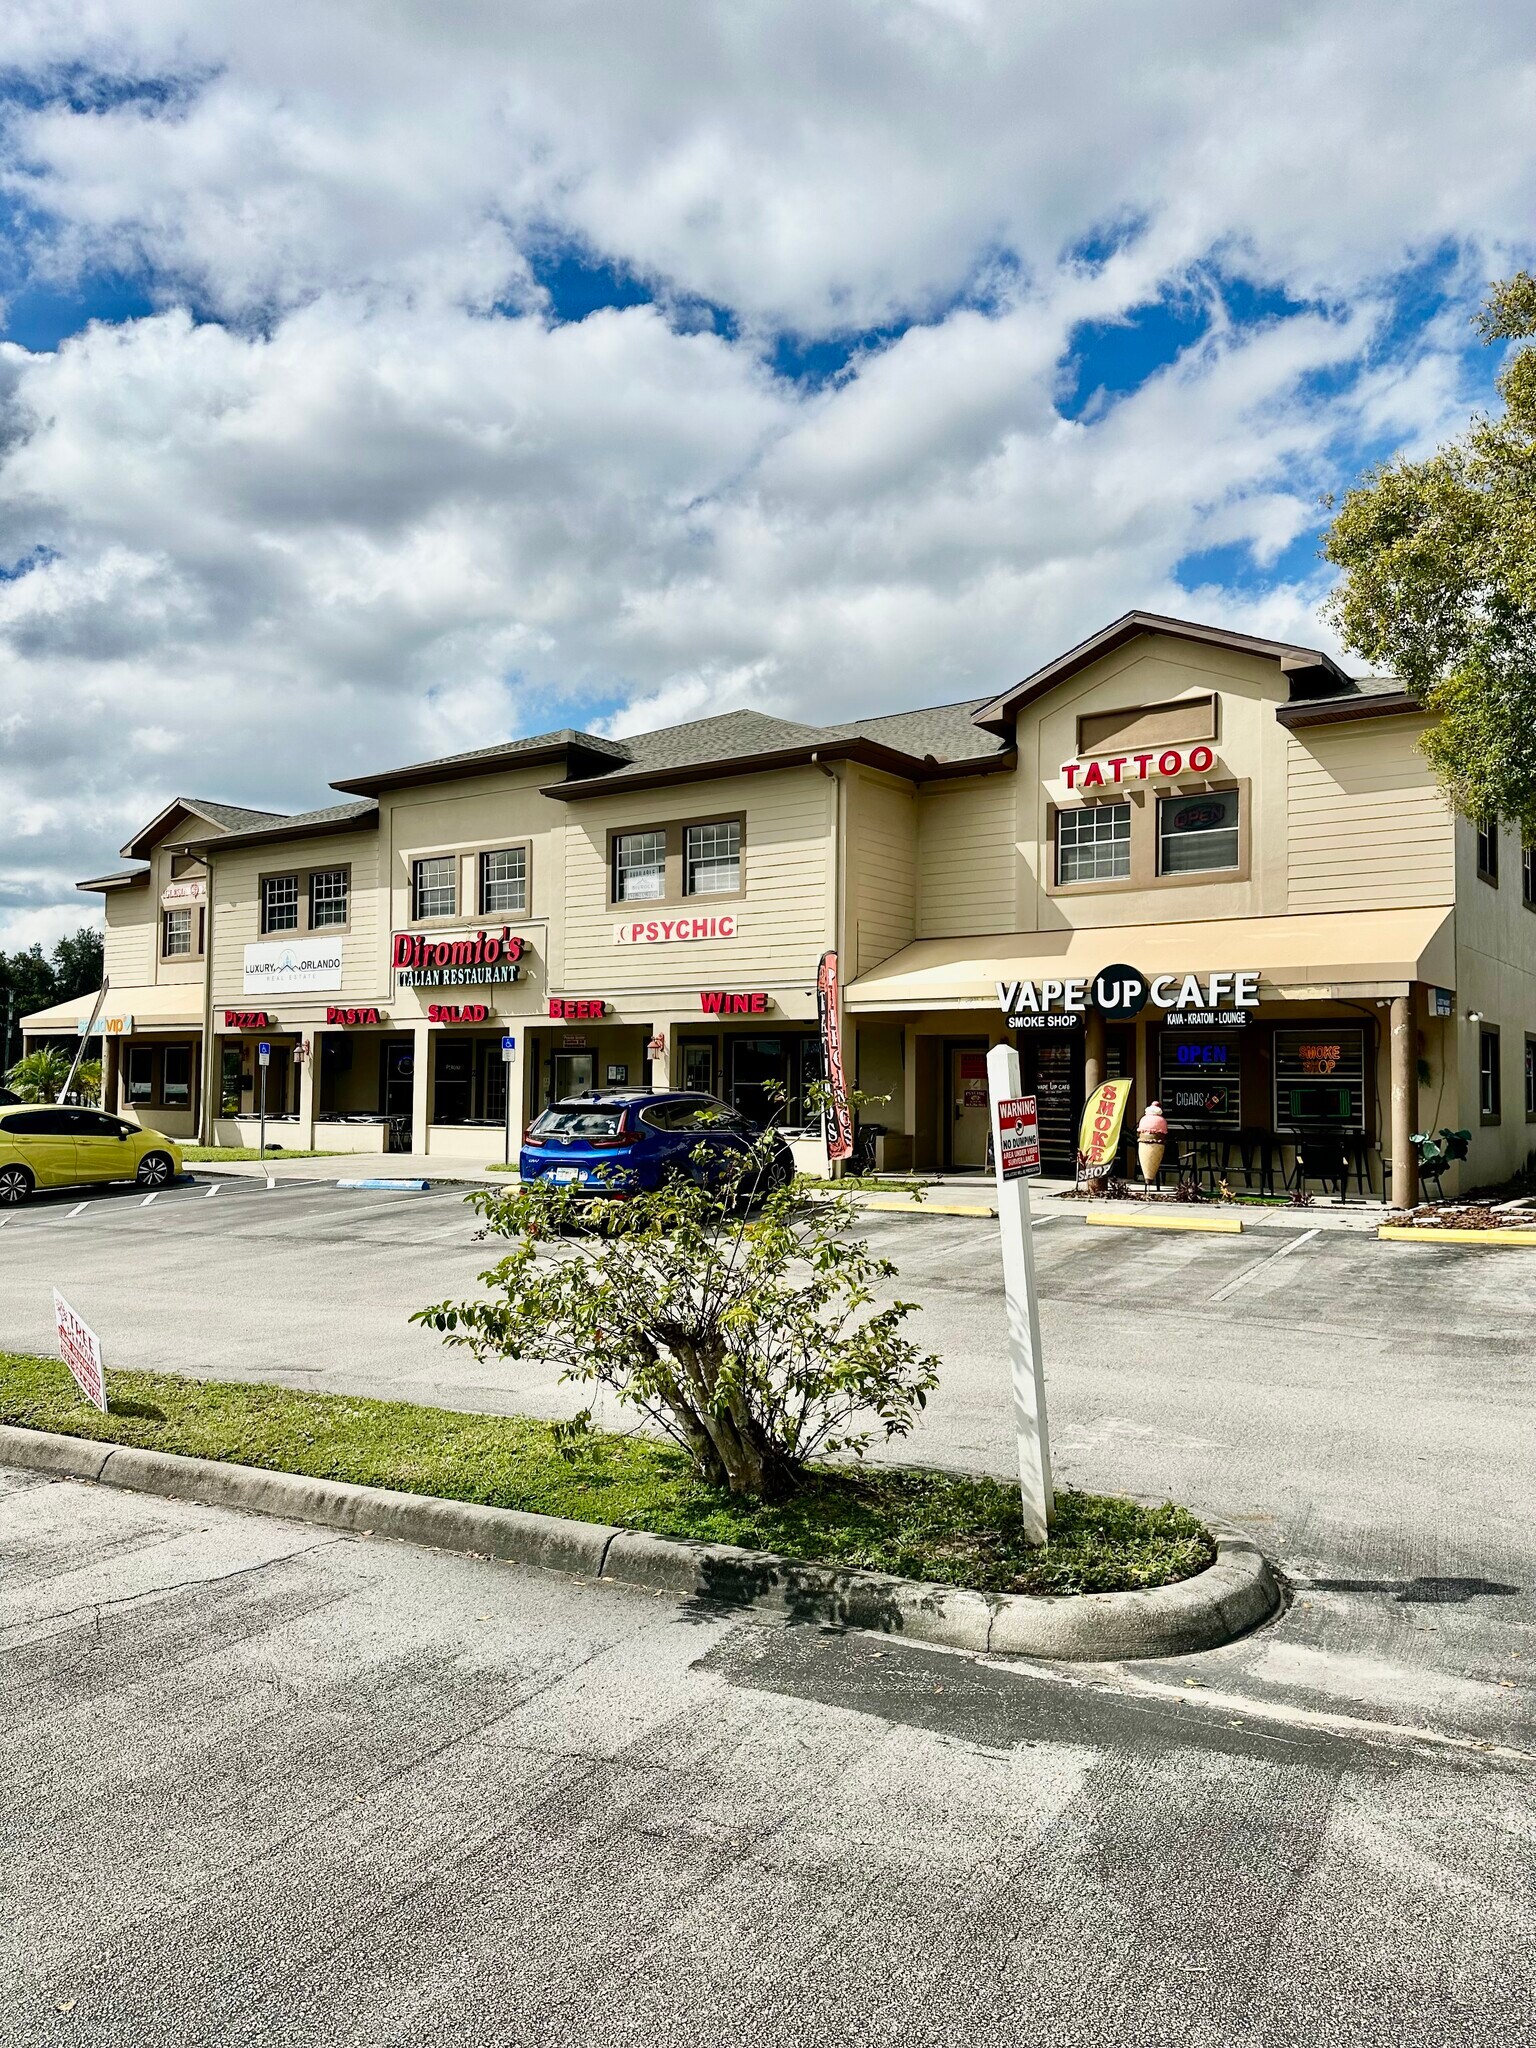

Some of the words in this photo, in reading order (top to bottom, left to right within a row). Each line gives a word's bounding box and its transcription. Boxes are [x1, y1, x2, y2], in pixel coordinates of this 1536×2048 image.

[1062, 746, 1213, 789] TATTOO
[1175, 807, 1224, 827] OPEN
[632, 916, 734, 941] PSYCHIC
[392, 926, 524, 968] Diromio's
[245, 963, 275, 973] LUXURY
[300, 958, 340, 970] ORLANDO
[289, 973, 316, 981] ESTATE
[397, 970, 440, 987] ITALIAN
[443, 965, 516, 985] RESTAURANT
[995, 979, 1087, 1012] VAPE
[1097, 977, 1142, 1008] UP
[1150, 971, 1261, 1009] CAFE
[550, 998, 607, 1019] BEER
[700, 992, 767, 1014] WINE
[224, 1010, 268, 1028] PIZZA
[326, 1006, 379, 1025] PASTA
[428, 1004, 488, 1023] SALAD
[1008, 1016, 1045, 1028] SMOKE
[1047, 1014, 1077, 1027] SHOP
[1177, 1045, 1227, 1064] OPEN
[1299, 1045, 1342, 1060] SMOKE
[1303, 1059, 1336, 1074] SHOP
[1000, 1099, 1036, 1119] WARNING
[1176, 1092, 1204, 1107] CIGARS
[1087, 1084, 1118, 1163] SMOKE
[1003, 1140, 1012, 1150] NO
[1012, 1135, 1037, 1149] DUMPING
[1003, 1150, 1014, 1160] AREA
[1014, 1148, 1027, 1158] UNDER
[1027, 1146, 1038, 1156] VIDEO
[1008, 1154, 1036, 1167] SURVEILLANCE
[1079, 1163, 1111, 1181] SHOP
